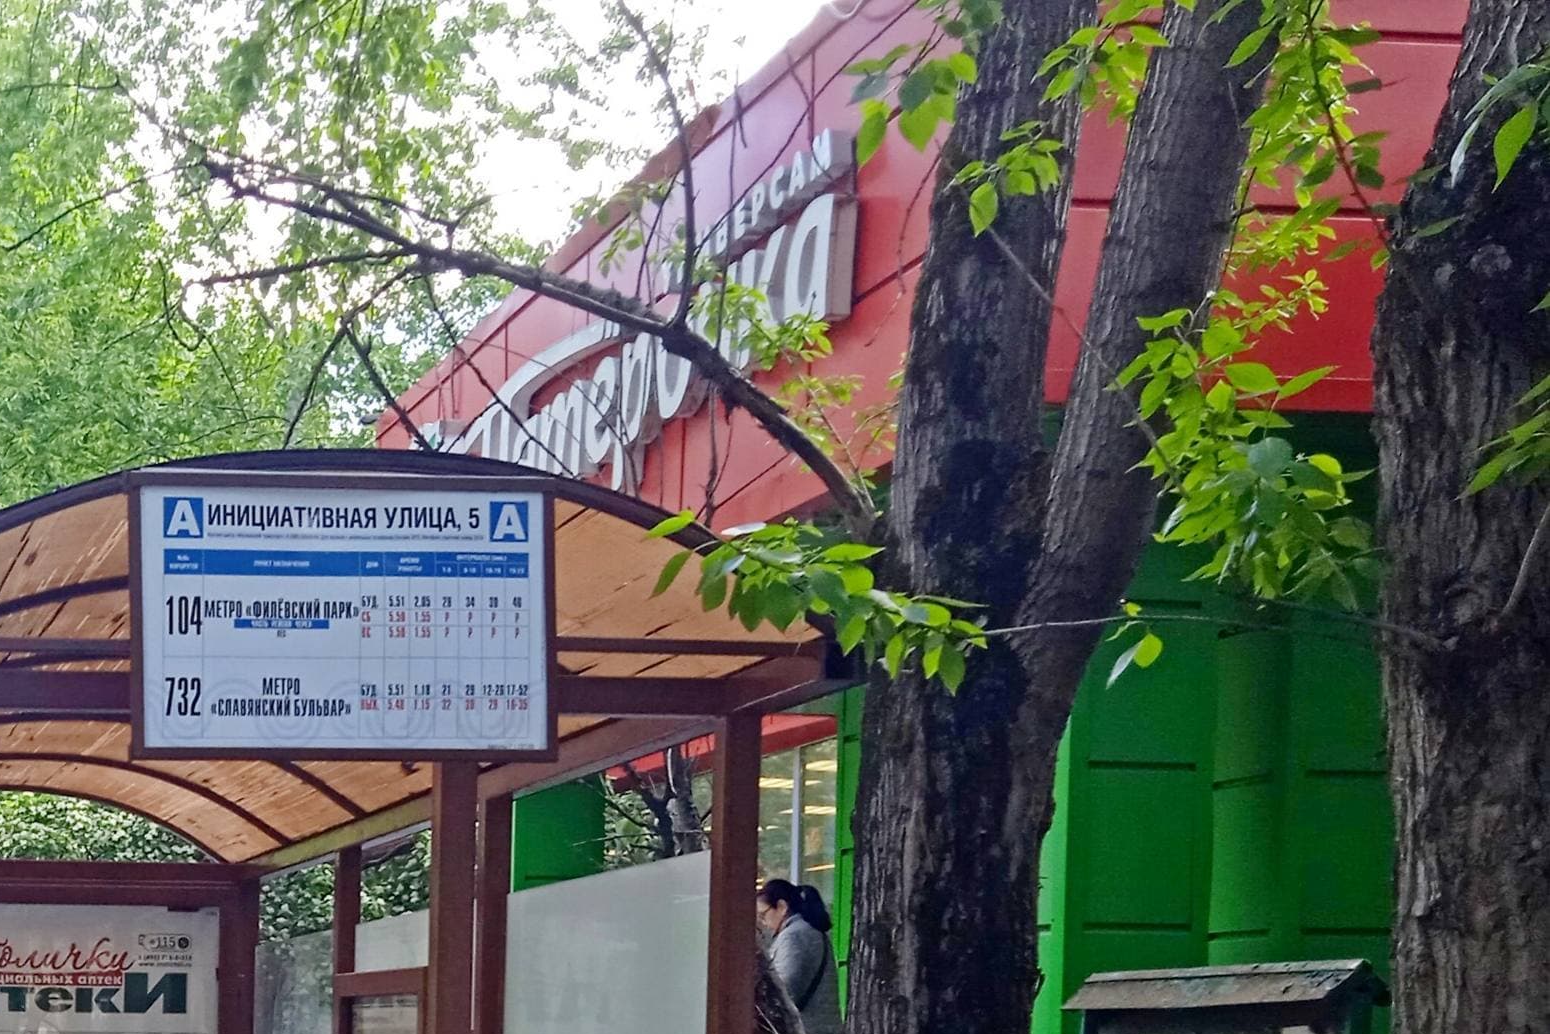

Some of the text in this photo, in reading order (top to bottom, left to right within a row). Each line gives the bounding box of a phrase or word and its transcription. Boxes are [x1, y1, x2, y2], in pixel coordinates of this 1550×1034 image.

[207, 504, 377, 531] ИНИЦИАТИВНАЯ
[384, 507, 461, 532] УЛИЦА,
[468, 507, 480, 529] 5
[165, 595, 202, 635] 104
[204, 600, 243, 618] МЕТРО
[324, 600, 360, 619] ПАРК»
[165, 677, 201, 716] 732
[262, 677, 300, 695] МЕТРО
[210, 696, 351, 717] «СЛАВЯНСКИЙ БУЛЬВАР»
[78, 975, 122, 986] аптек
